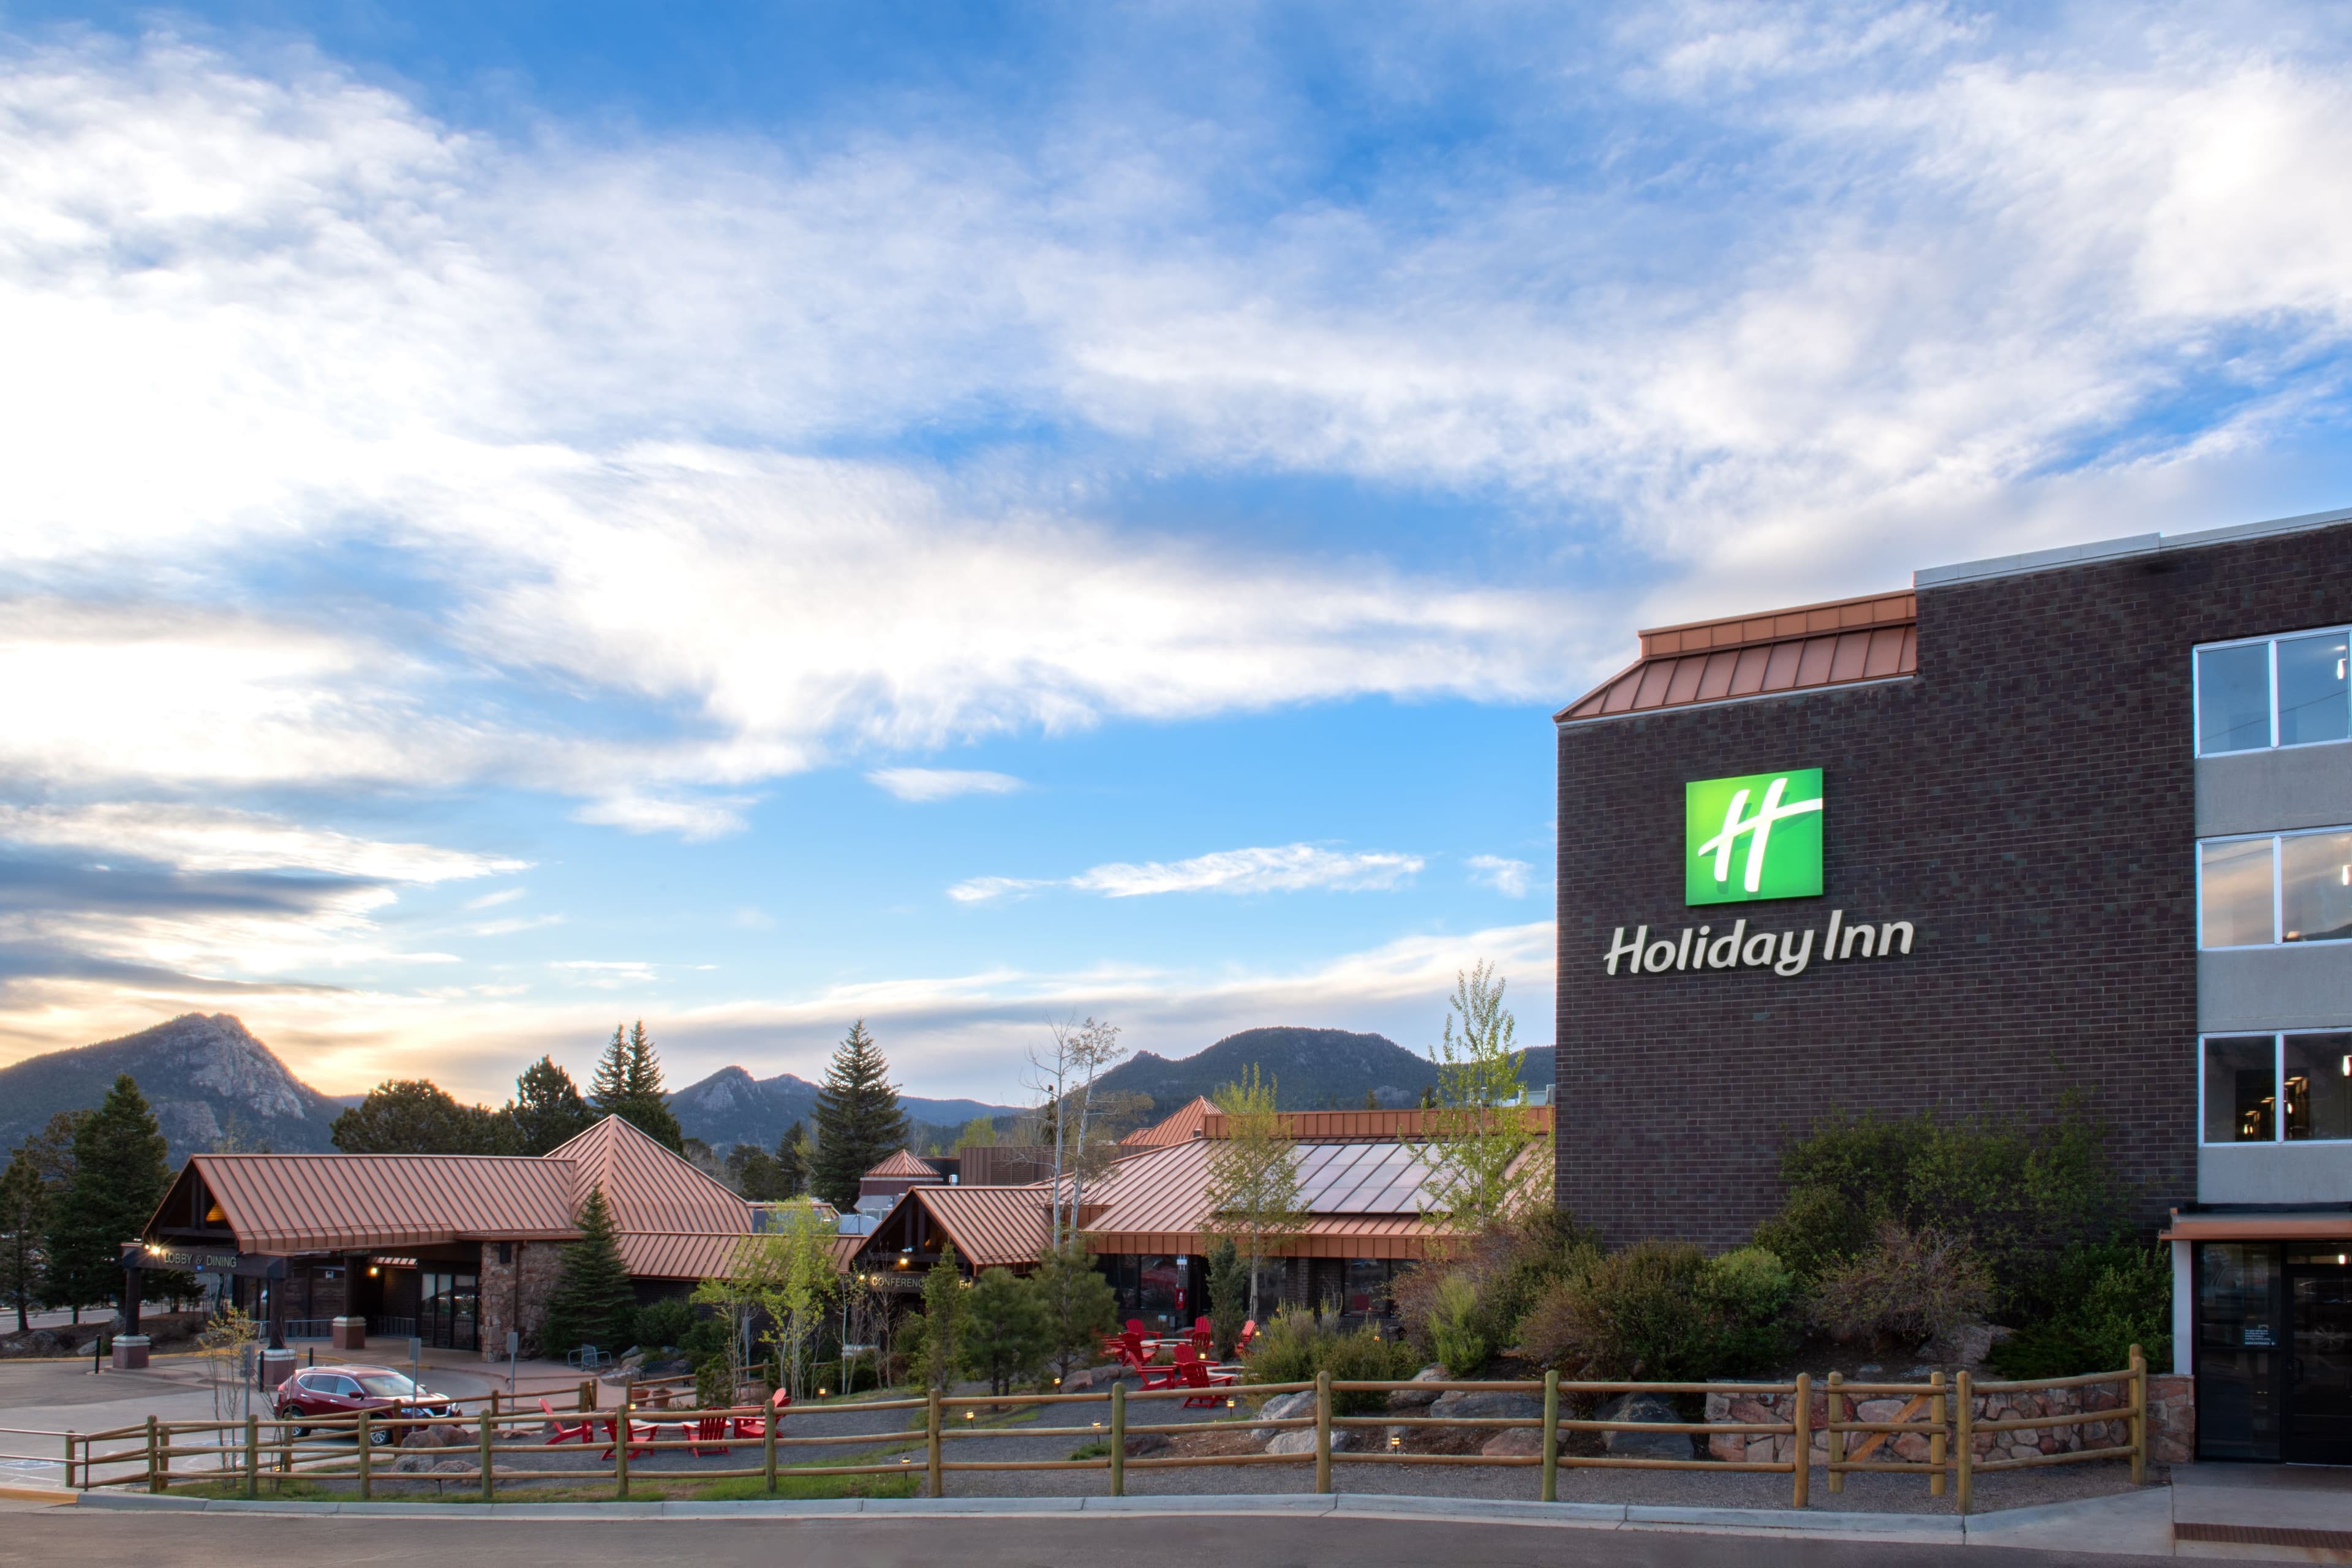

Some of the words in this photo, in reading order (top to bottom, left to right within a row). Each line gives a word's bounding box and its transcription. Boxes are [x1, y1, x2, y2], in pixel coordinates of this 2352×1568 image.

[1604, 919, 1814, 976] Holiday
[1824, 910, 1915, 961] Inn
[164, 1253, 192, 1264] LOBBY
[196, 1256, 203, 1264] &
[206, 1256, 237, 1267] DINING
[872, 1277, 924, 1288] CONFERENC
